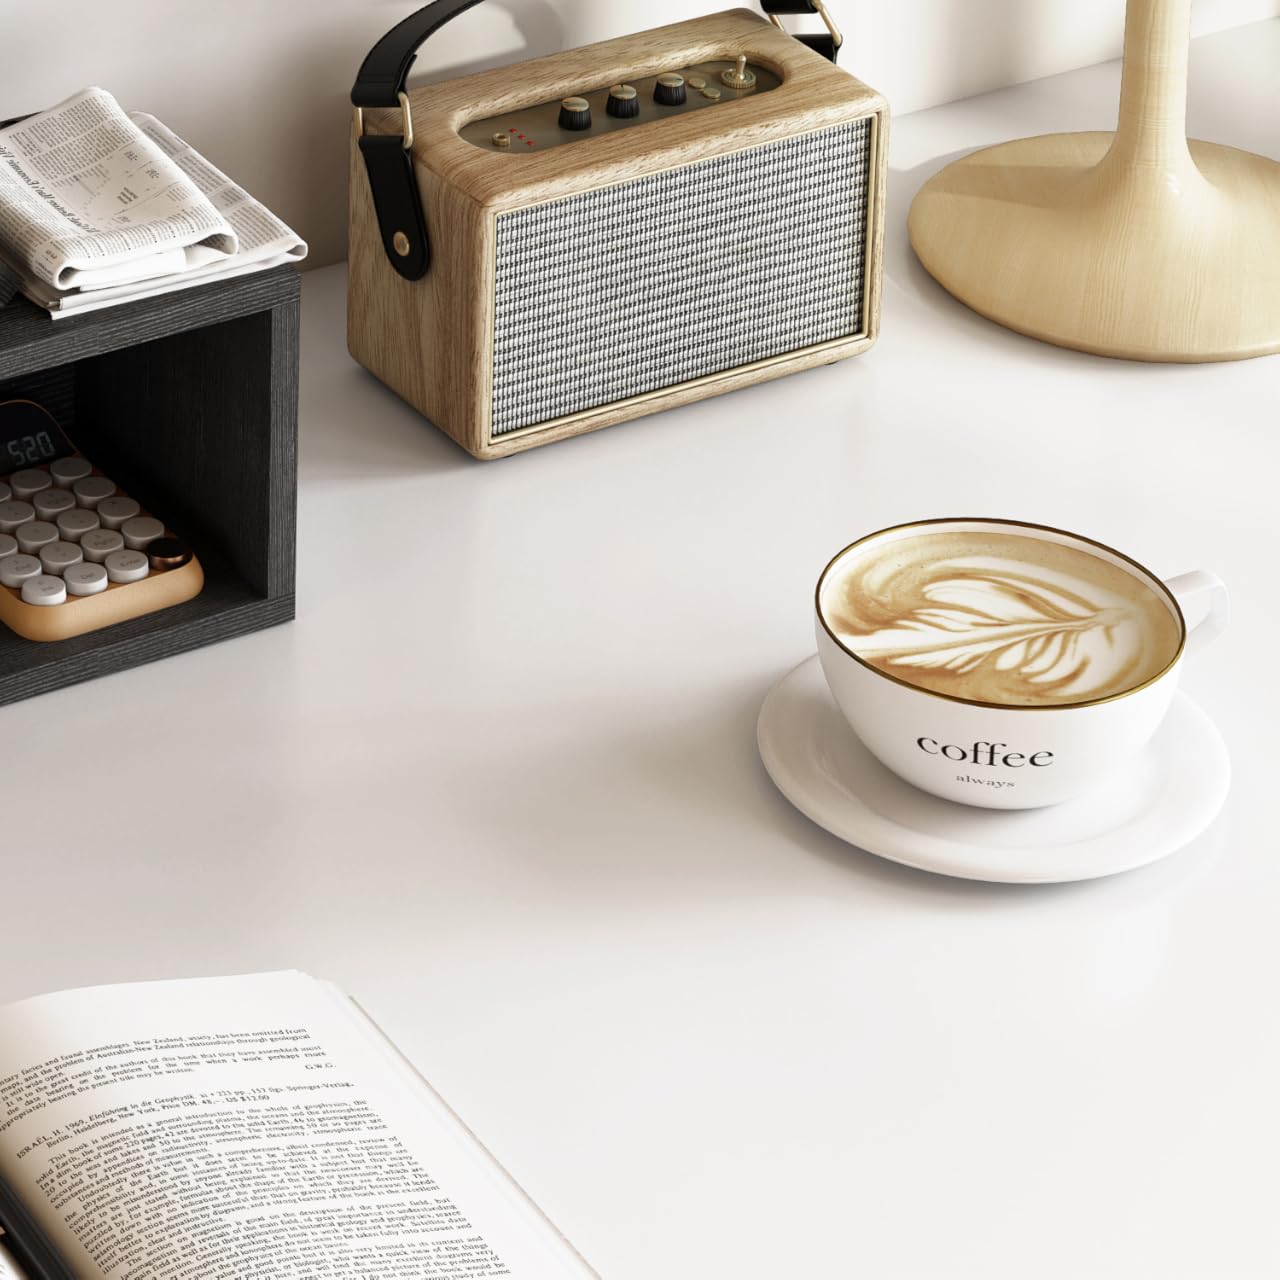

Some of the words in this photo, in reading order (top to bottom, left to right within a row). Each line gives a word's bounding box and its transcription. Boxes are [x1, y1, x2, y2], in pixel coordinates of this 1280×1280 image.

[7, 431, 57, 466] 520
[916, 736, 1054, 768] coffee
[955, 774, 1016, 789] always
